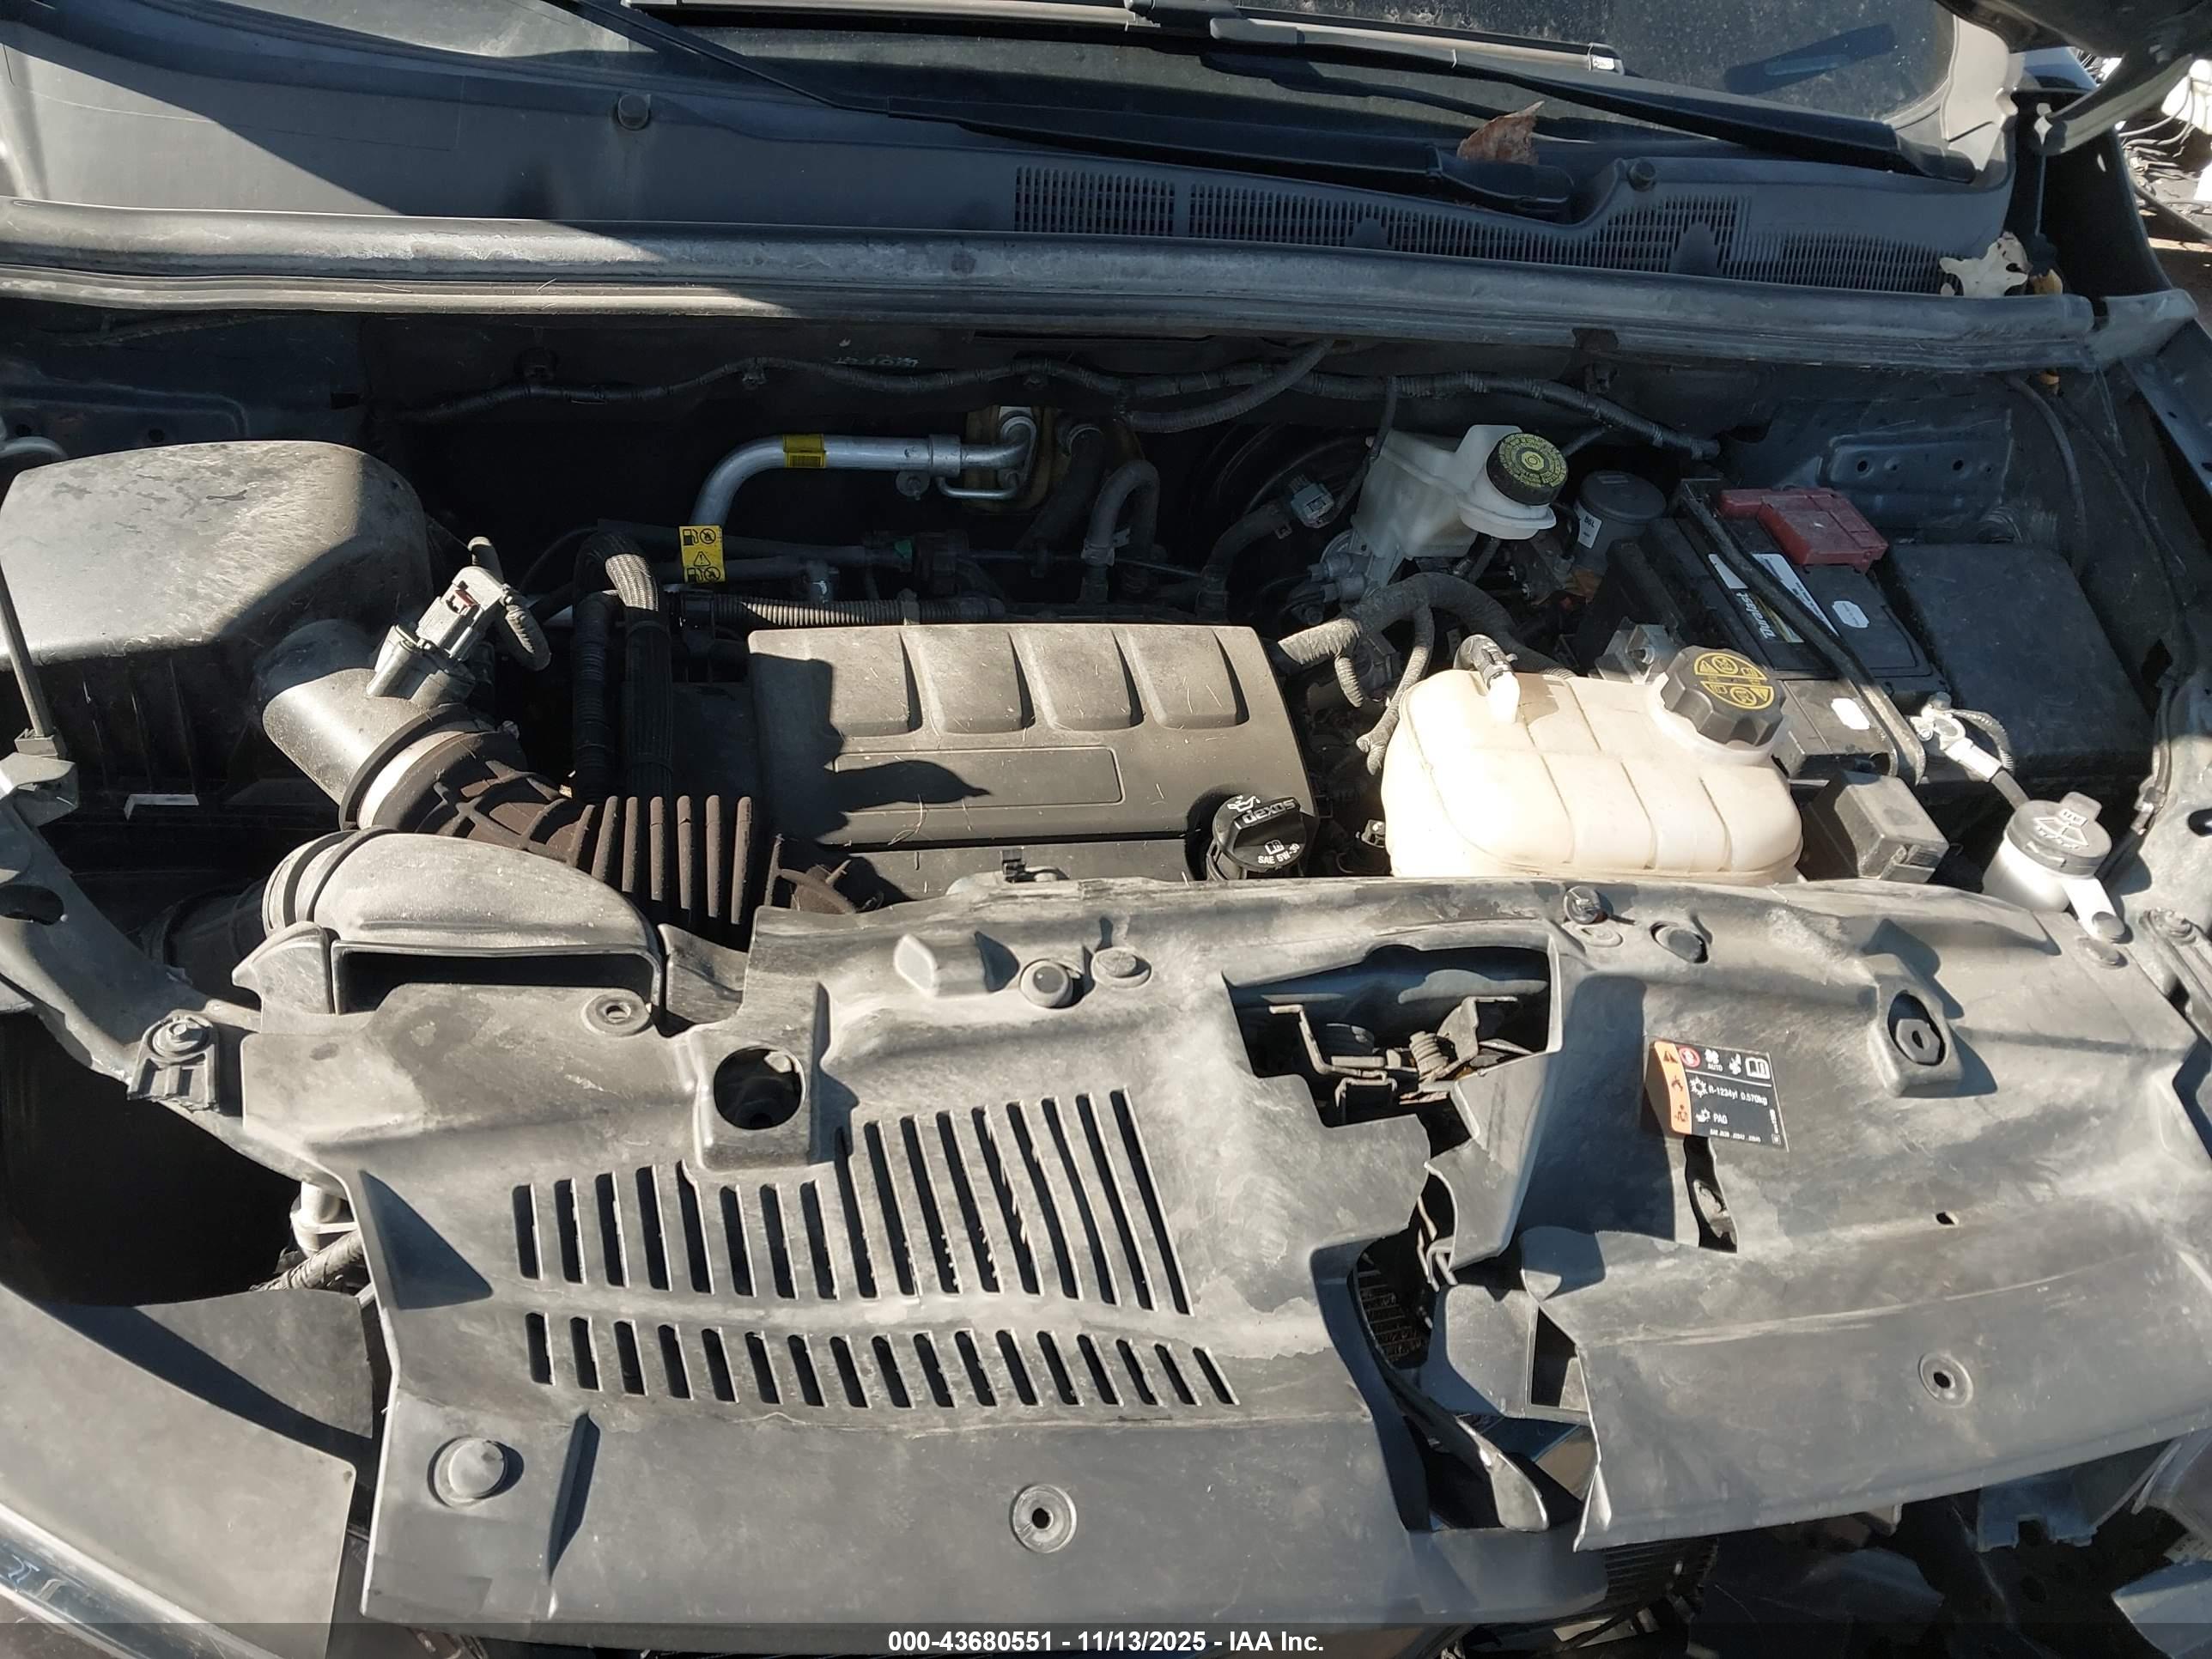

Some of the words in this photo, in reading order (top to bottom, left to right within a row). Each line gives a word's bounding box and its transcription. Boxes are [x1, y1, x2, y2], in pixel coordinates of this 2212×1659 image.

[1735, 592, 1777, 640] Duralast
[1242, 798, 1296, 824] dexos
[1257, 855, 1275, 865] SAE
[1277, 843, 1301, 863] 5W-30
[1707, 1063, 1723, 1073] AUTO
